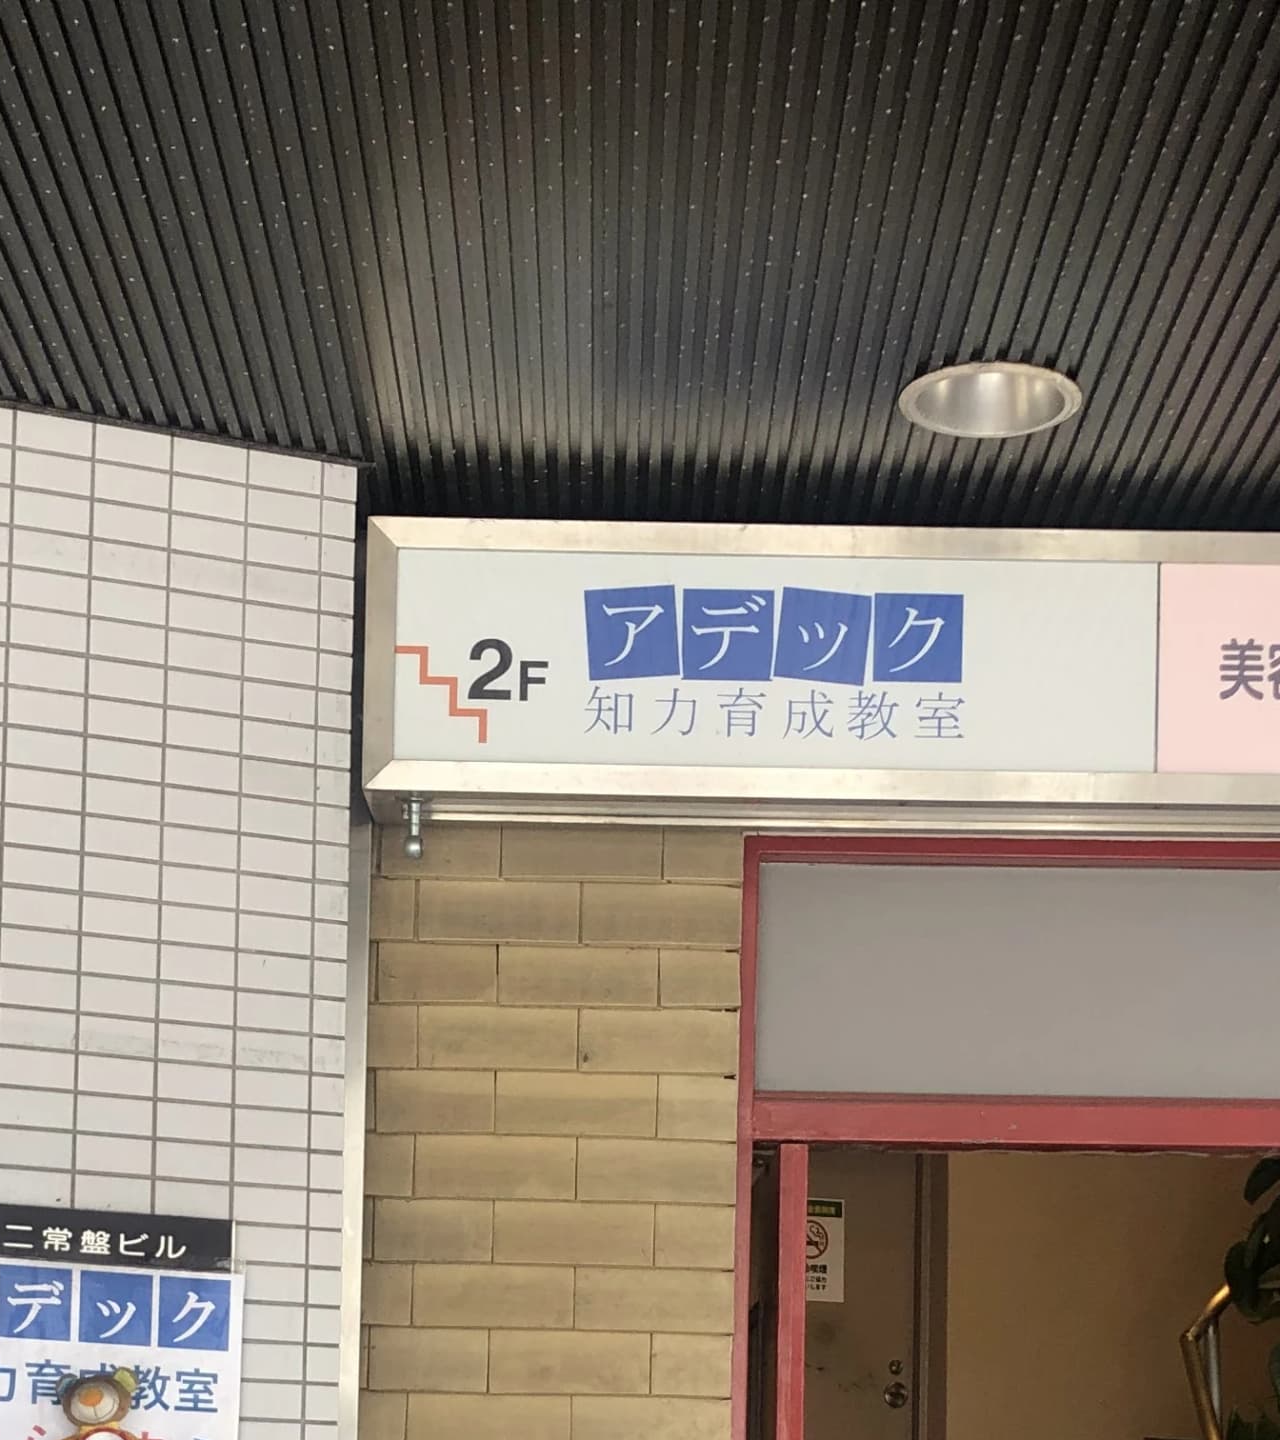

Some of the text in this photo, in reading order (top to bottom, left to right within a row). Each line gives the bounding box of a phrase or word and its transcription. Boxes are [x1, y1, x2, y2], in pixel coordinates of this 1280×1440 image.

[600, 592, 946, 676] アデック
[466, 638, 550, 701] 2F
[583, 686, 966, 741] 知力育成教室
